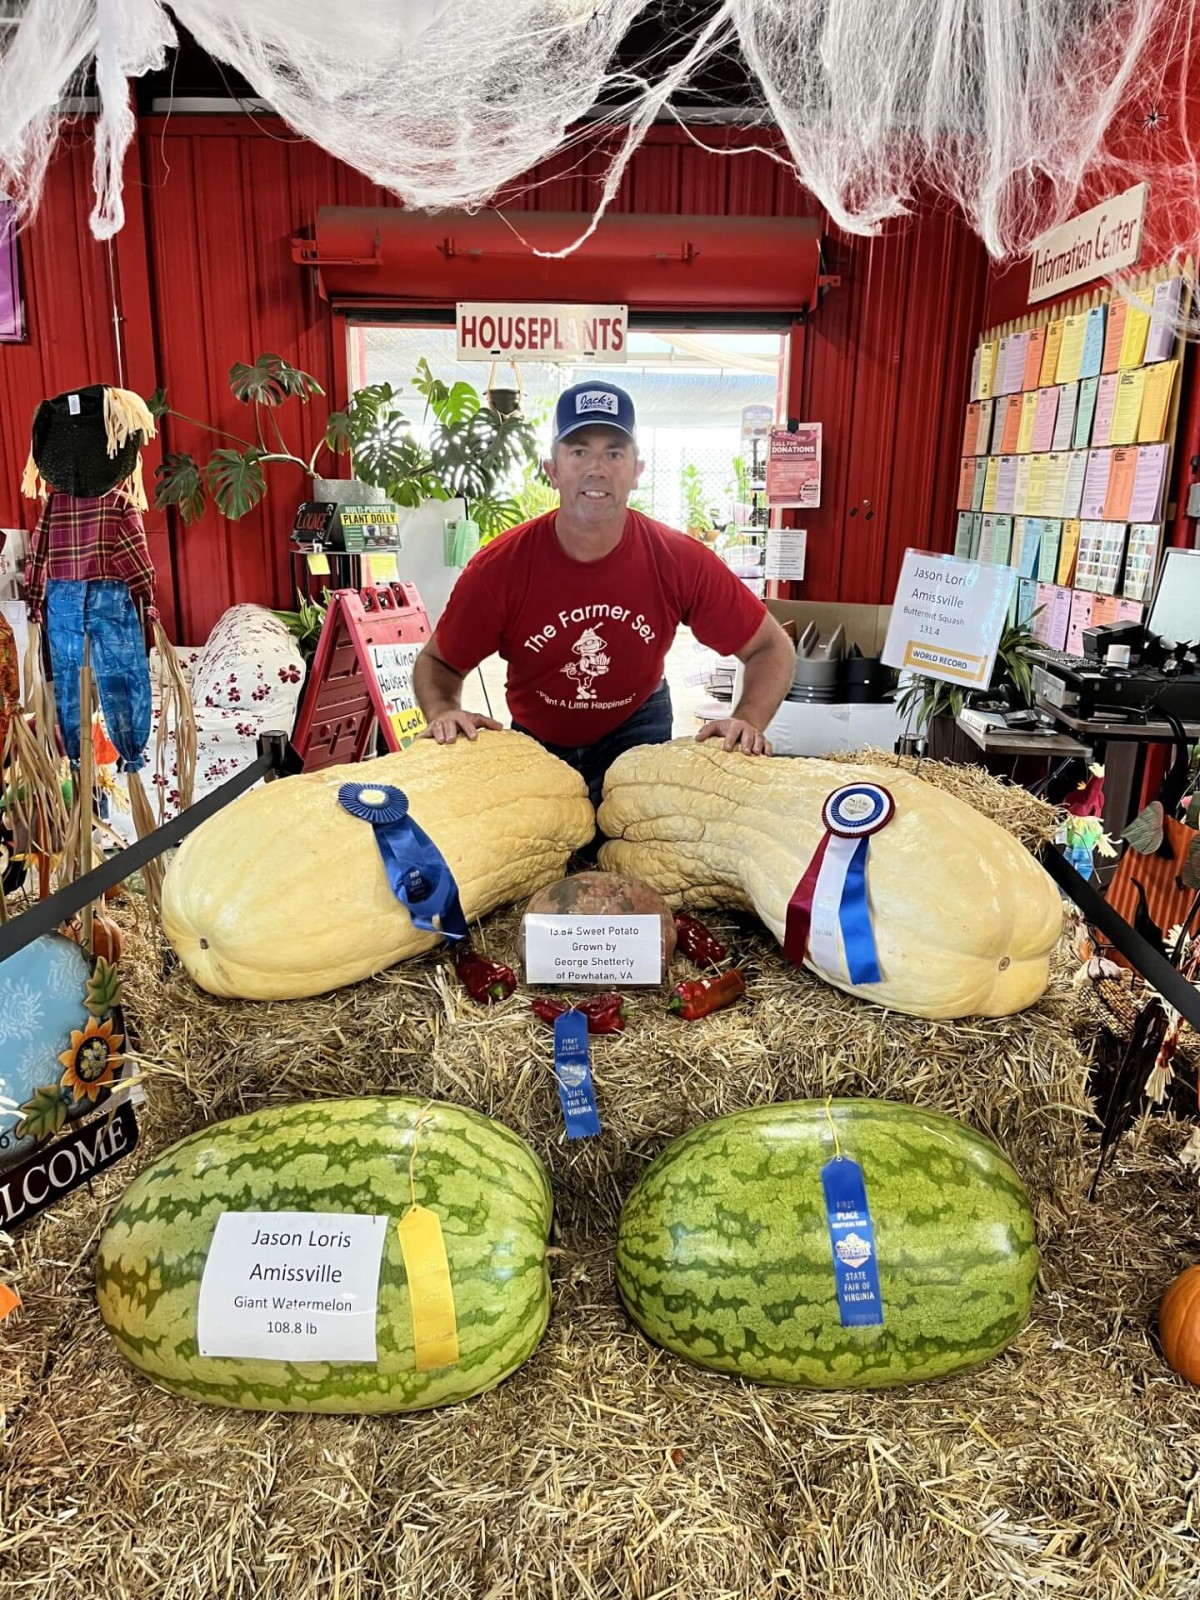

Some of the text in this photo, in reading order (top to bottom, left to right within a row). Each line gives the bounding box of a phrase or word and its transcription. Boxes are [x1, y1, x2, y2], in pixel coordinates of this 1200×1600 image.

[1032, 214, 1138, 289] Information Center
[461, 315, 624, 351] HOUSEPLANTS
[580, 394, 614, 410] Jack's
[344, 505, 391, 514] MULTI-PURPOSE
[343, 513, 396, 524] PLANT DOLLY
[913, 566, 943, 582] Jason
[911, 588, 965, 609] Amissville
[903, 605, 965, 627] Butternut Squash
[524, 604, 656, 653] The Farmer Sez
[919, 624, 940, 636] 131.4
[912, 649, 968, 670] WORLD RECORD
[377, 671, 412, 694] Housepl
[391, 697, 413, 713] This
[568, 700, 589, 709] Little
[576, 926, 605, 936] Sweet
[608, 926, 639, 936] Potato
[572, 942, 617, 953] Grown by
[554, 957, 635, 968] George Shetterly
[556, 971, 633, 981] of Powhatan, VA
[562, 1037, 578, 1045] FIRST
[561, 1044, 579, 1052] PLACE
[567, 1089, 585, 1098] STATE
[567, 1099, 580, 1107] FAIR
[567, 1104, 592, 1116] VIRGINIA
[0, 1117, 127, 1226] LCOME
[836, 1210, 859, 1221] PLACE
[251, 1229, 351, 1248] Jason Loris
[249, 1263, 342, 1283] Amissville
[845, 1271, 867, 1281] STATE
[844, 1281, 870, 1292] FAIR OF
[843, 1290, 875, 1302] VIRGINIA
[234, 1295, 352, 1312] Giant Watermelon
[267, 1321, 317, 1335] 108.8 lb
